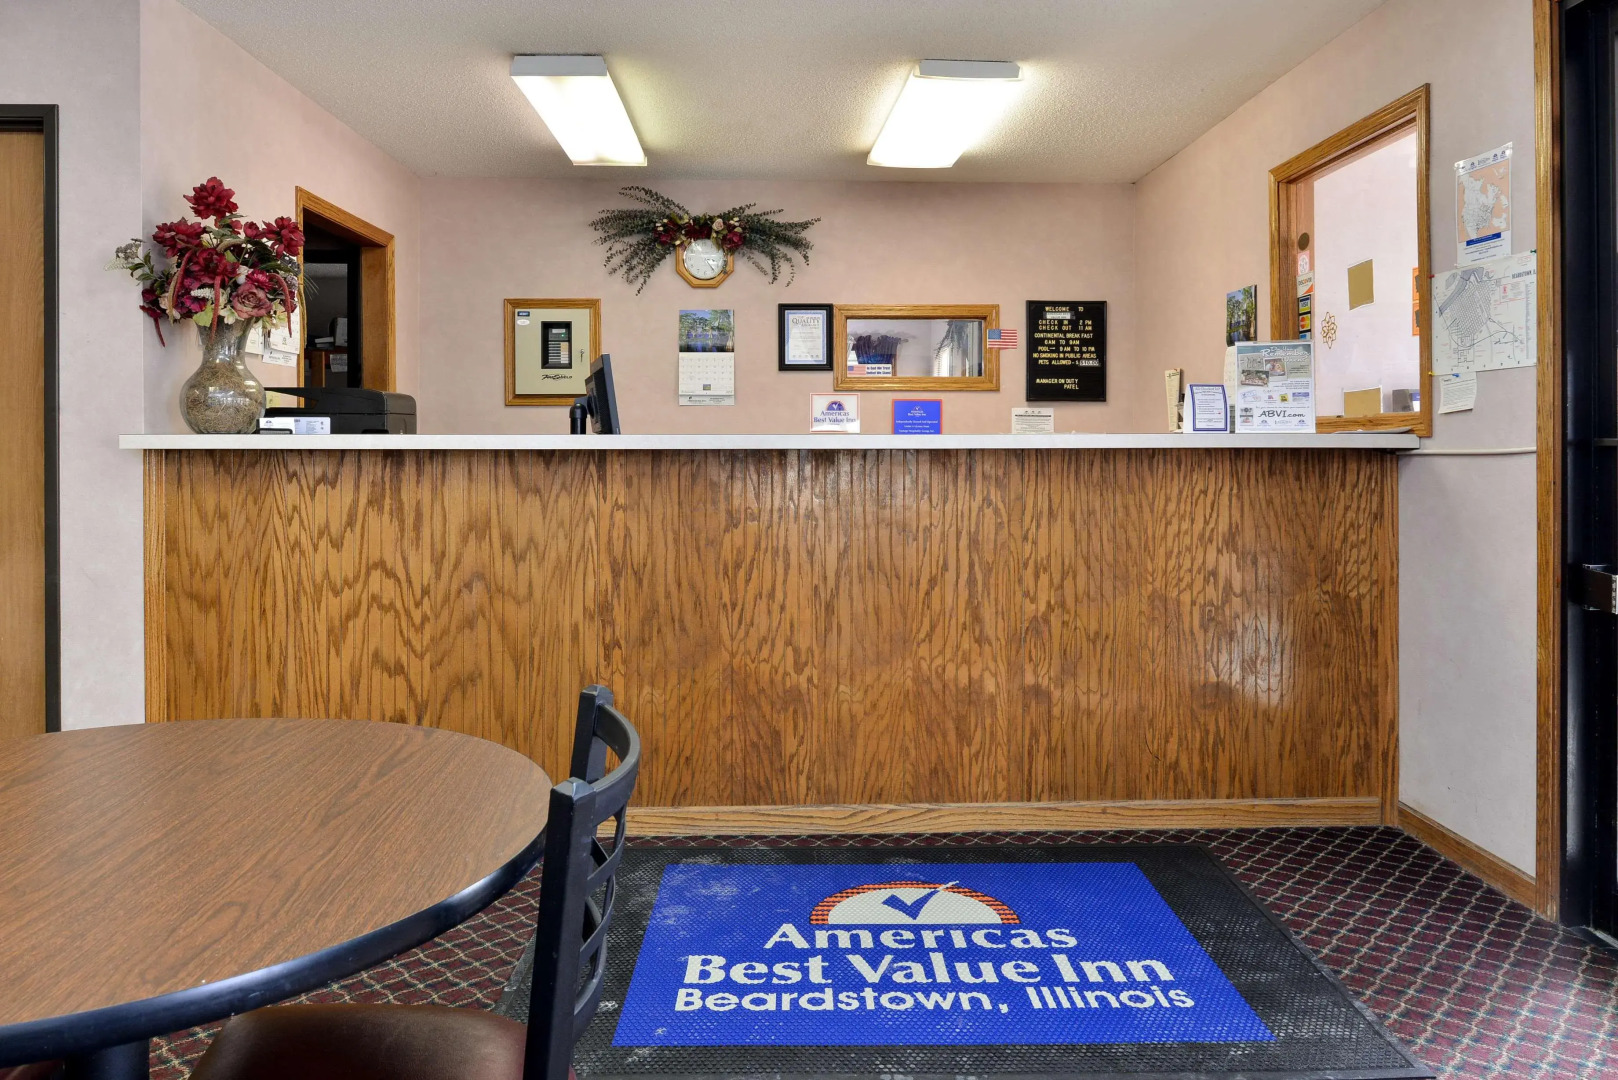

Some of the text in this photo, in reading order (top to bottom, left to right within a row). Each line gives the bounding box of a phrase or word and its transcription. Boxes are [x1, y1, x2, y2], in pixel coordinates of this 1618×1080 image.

[1260, 349, 1310, 358] Remember
[763, 923, 1078, 949] Americas
[683, 952, 1175, 984] Best Value Inn
[675, 986, 1195, 1013] Beardstown, Illinois
